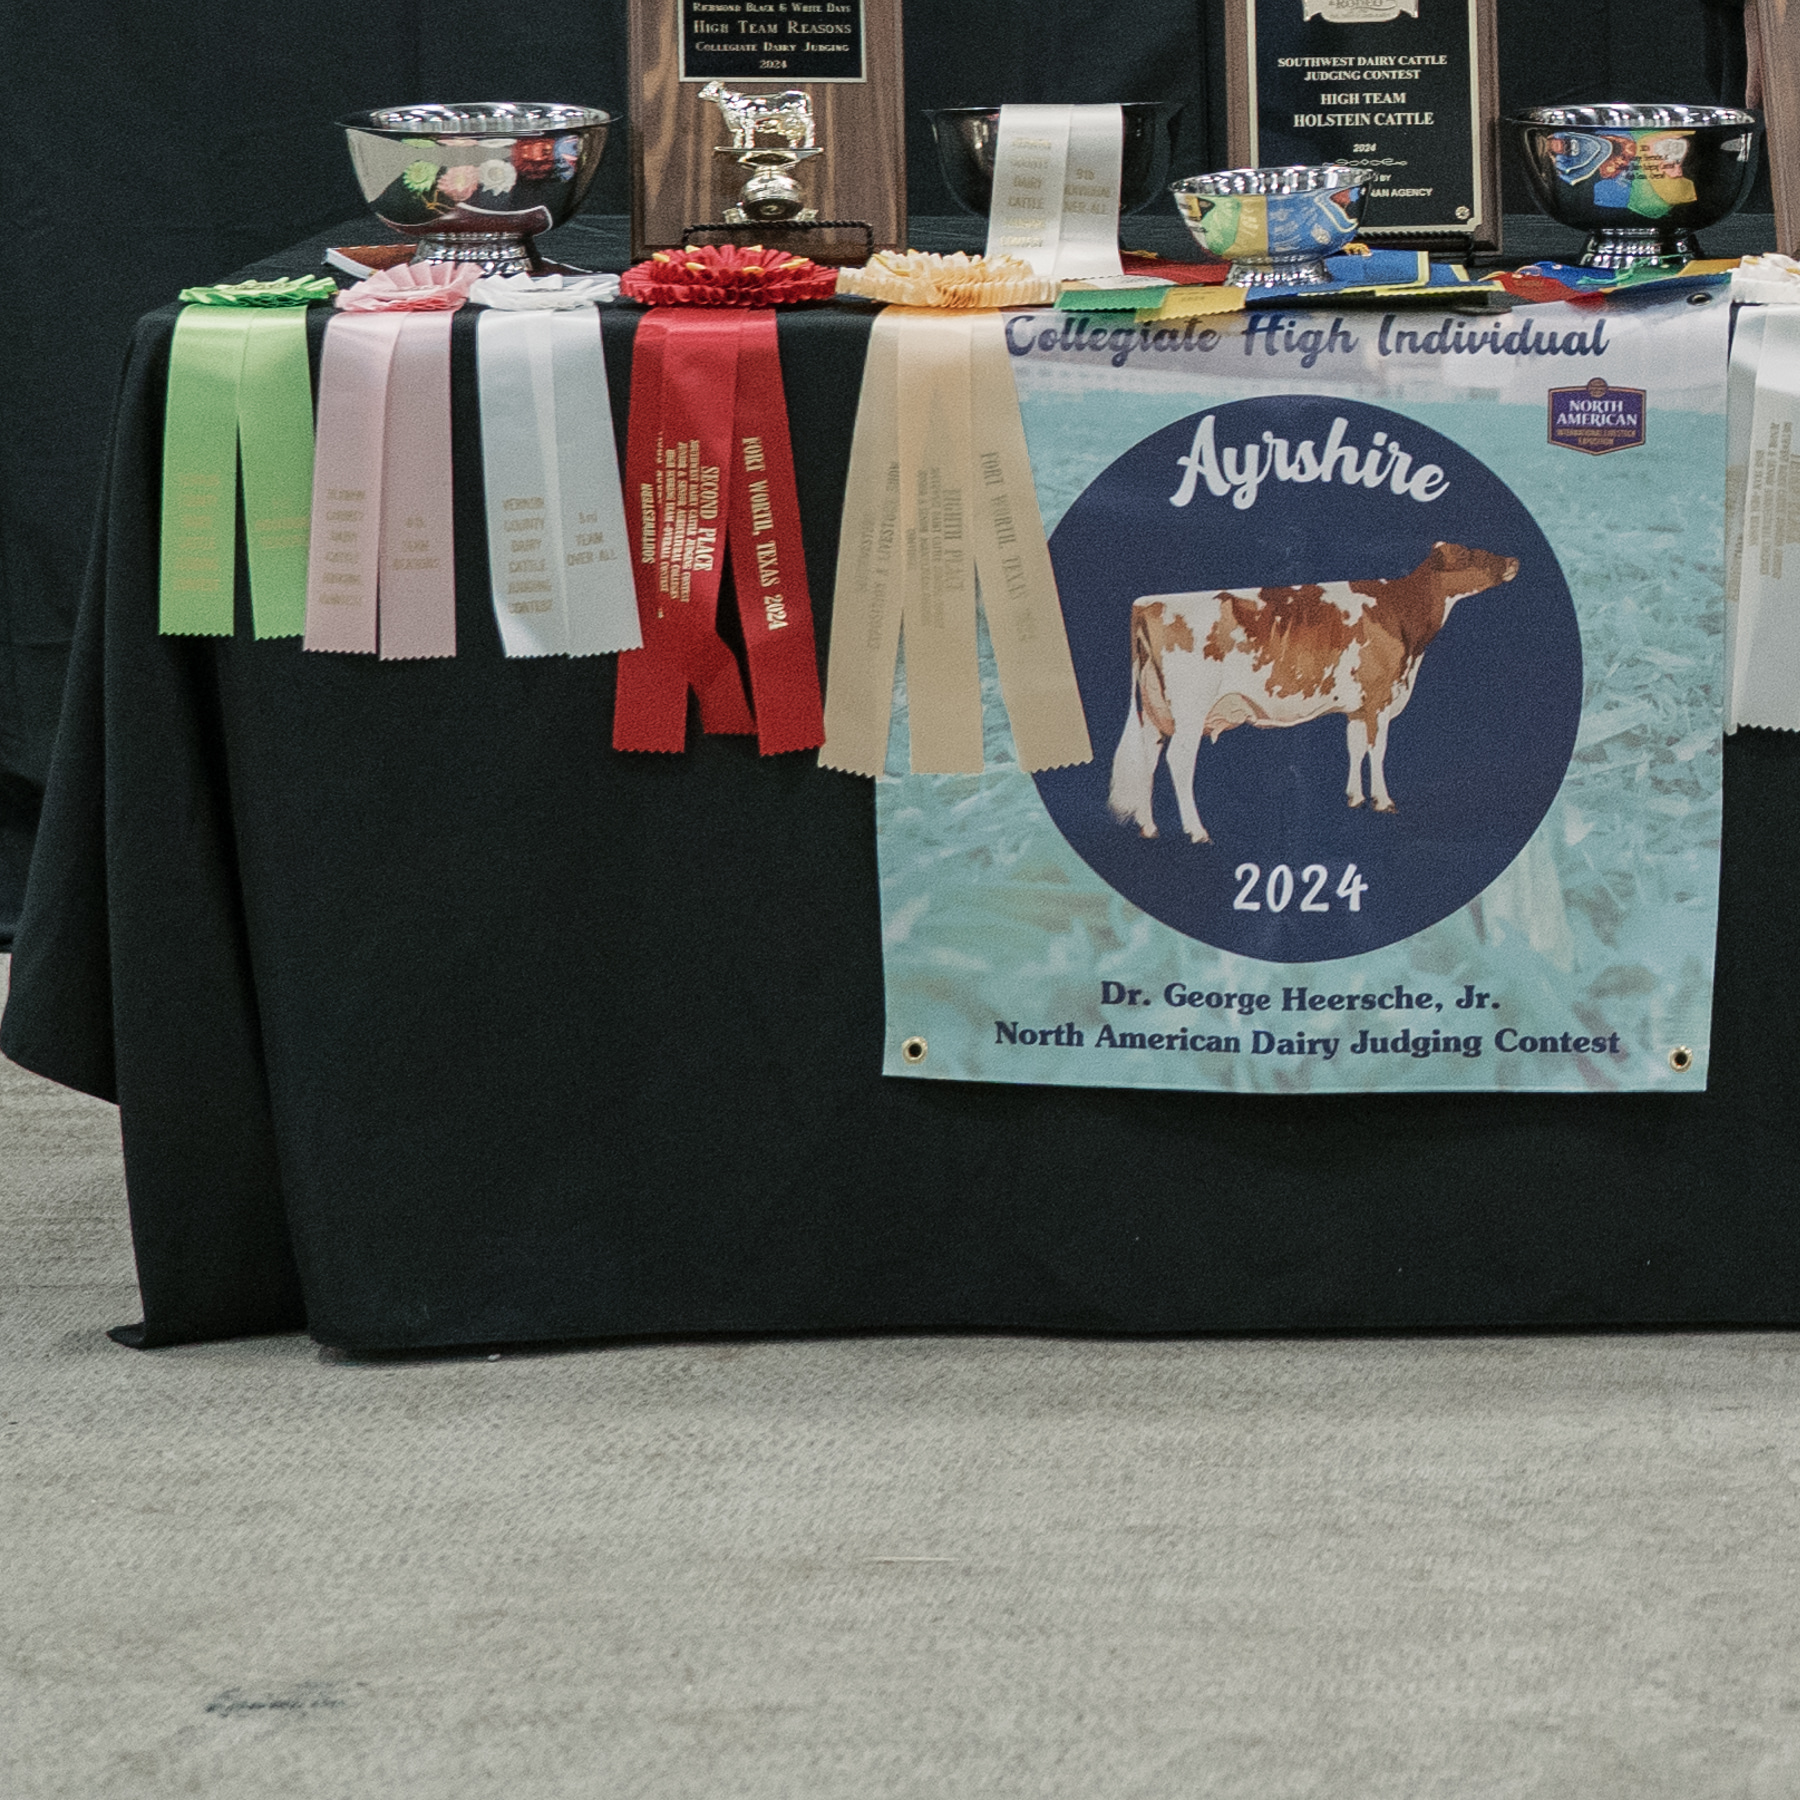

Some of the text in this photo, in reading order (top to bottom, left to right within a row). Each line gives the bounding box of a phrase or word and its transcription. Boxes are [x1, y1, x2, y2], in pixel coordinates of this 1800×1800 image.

[759, 60, 788, 69] 2024
[1277, 54, 1448, 68] SOUTHWEST DAIRY CATTLE
[1304, 69, 1421, 81] JUDGING CONTEST
[1320, 92, 1407, 105] HIGH TEAM
[1293, 111, 1435, 127] HOLSTEIN CATTLE
[1353, 143, 1377, 153] 2024
[1391, 188, 1433, 198] AGENCY
[1005, 313, 1610, 368] Collegiate High Individual
[1569, 400, 1623, 411] NORTH
[1556, 413, 1637, 425] AMERICAN
[1169, 414, 1450, 510] Ayrshire
[693, 466, 719, 571] SECOND PLACE
[756, 540, 781, 587] TEXAS
[764, 595, 788, 630] 2024
[1232, 862, 1368, 913] 2024
[1099, 981, 1500, 1014] Dr. George Heersche, Jr.
[993, 1021, 1621, 1059] North American Dairy Judging Contest
